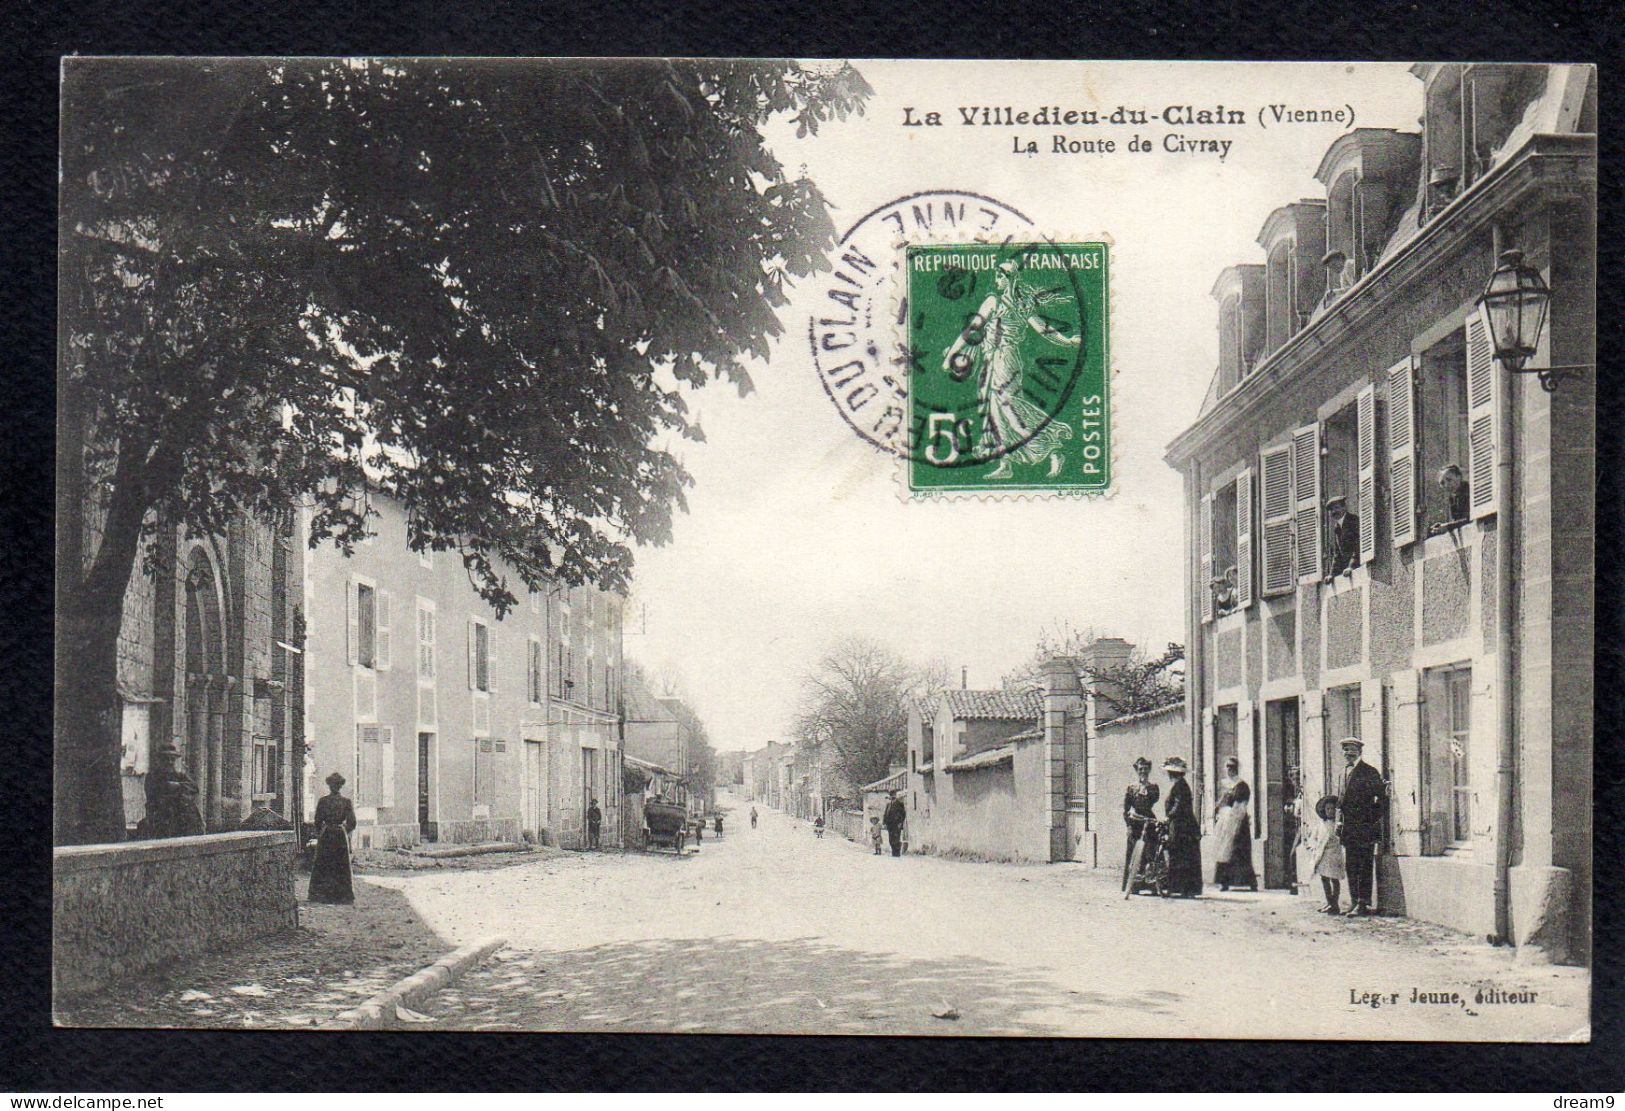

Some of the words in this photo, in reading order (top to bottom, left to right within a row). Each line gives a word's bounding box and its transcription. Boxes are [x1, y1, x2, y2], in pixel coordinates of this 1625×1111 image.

[902, 107, 943, 126] La
[958, 105, 1246, 126] Villedieu-du-Clain
[1258, 103, 1356, 129] (Vienne)
[1012, 136, 1039, 153] La
[1052, 135, 1116, 153] Route
[1128, 134, 1152, 153] de
[1162, 134, 1233, 158] Civray
[925, 413, 960, 465] 5
[1083, 394, 1101, 475] POSTES
[1410, 988, 1466, 1007] Jeune,
[1474, 989, 1539, 1004] éditeur
